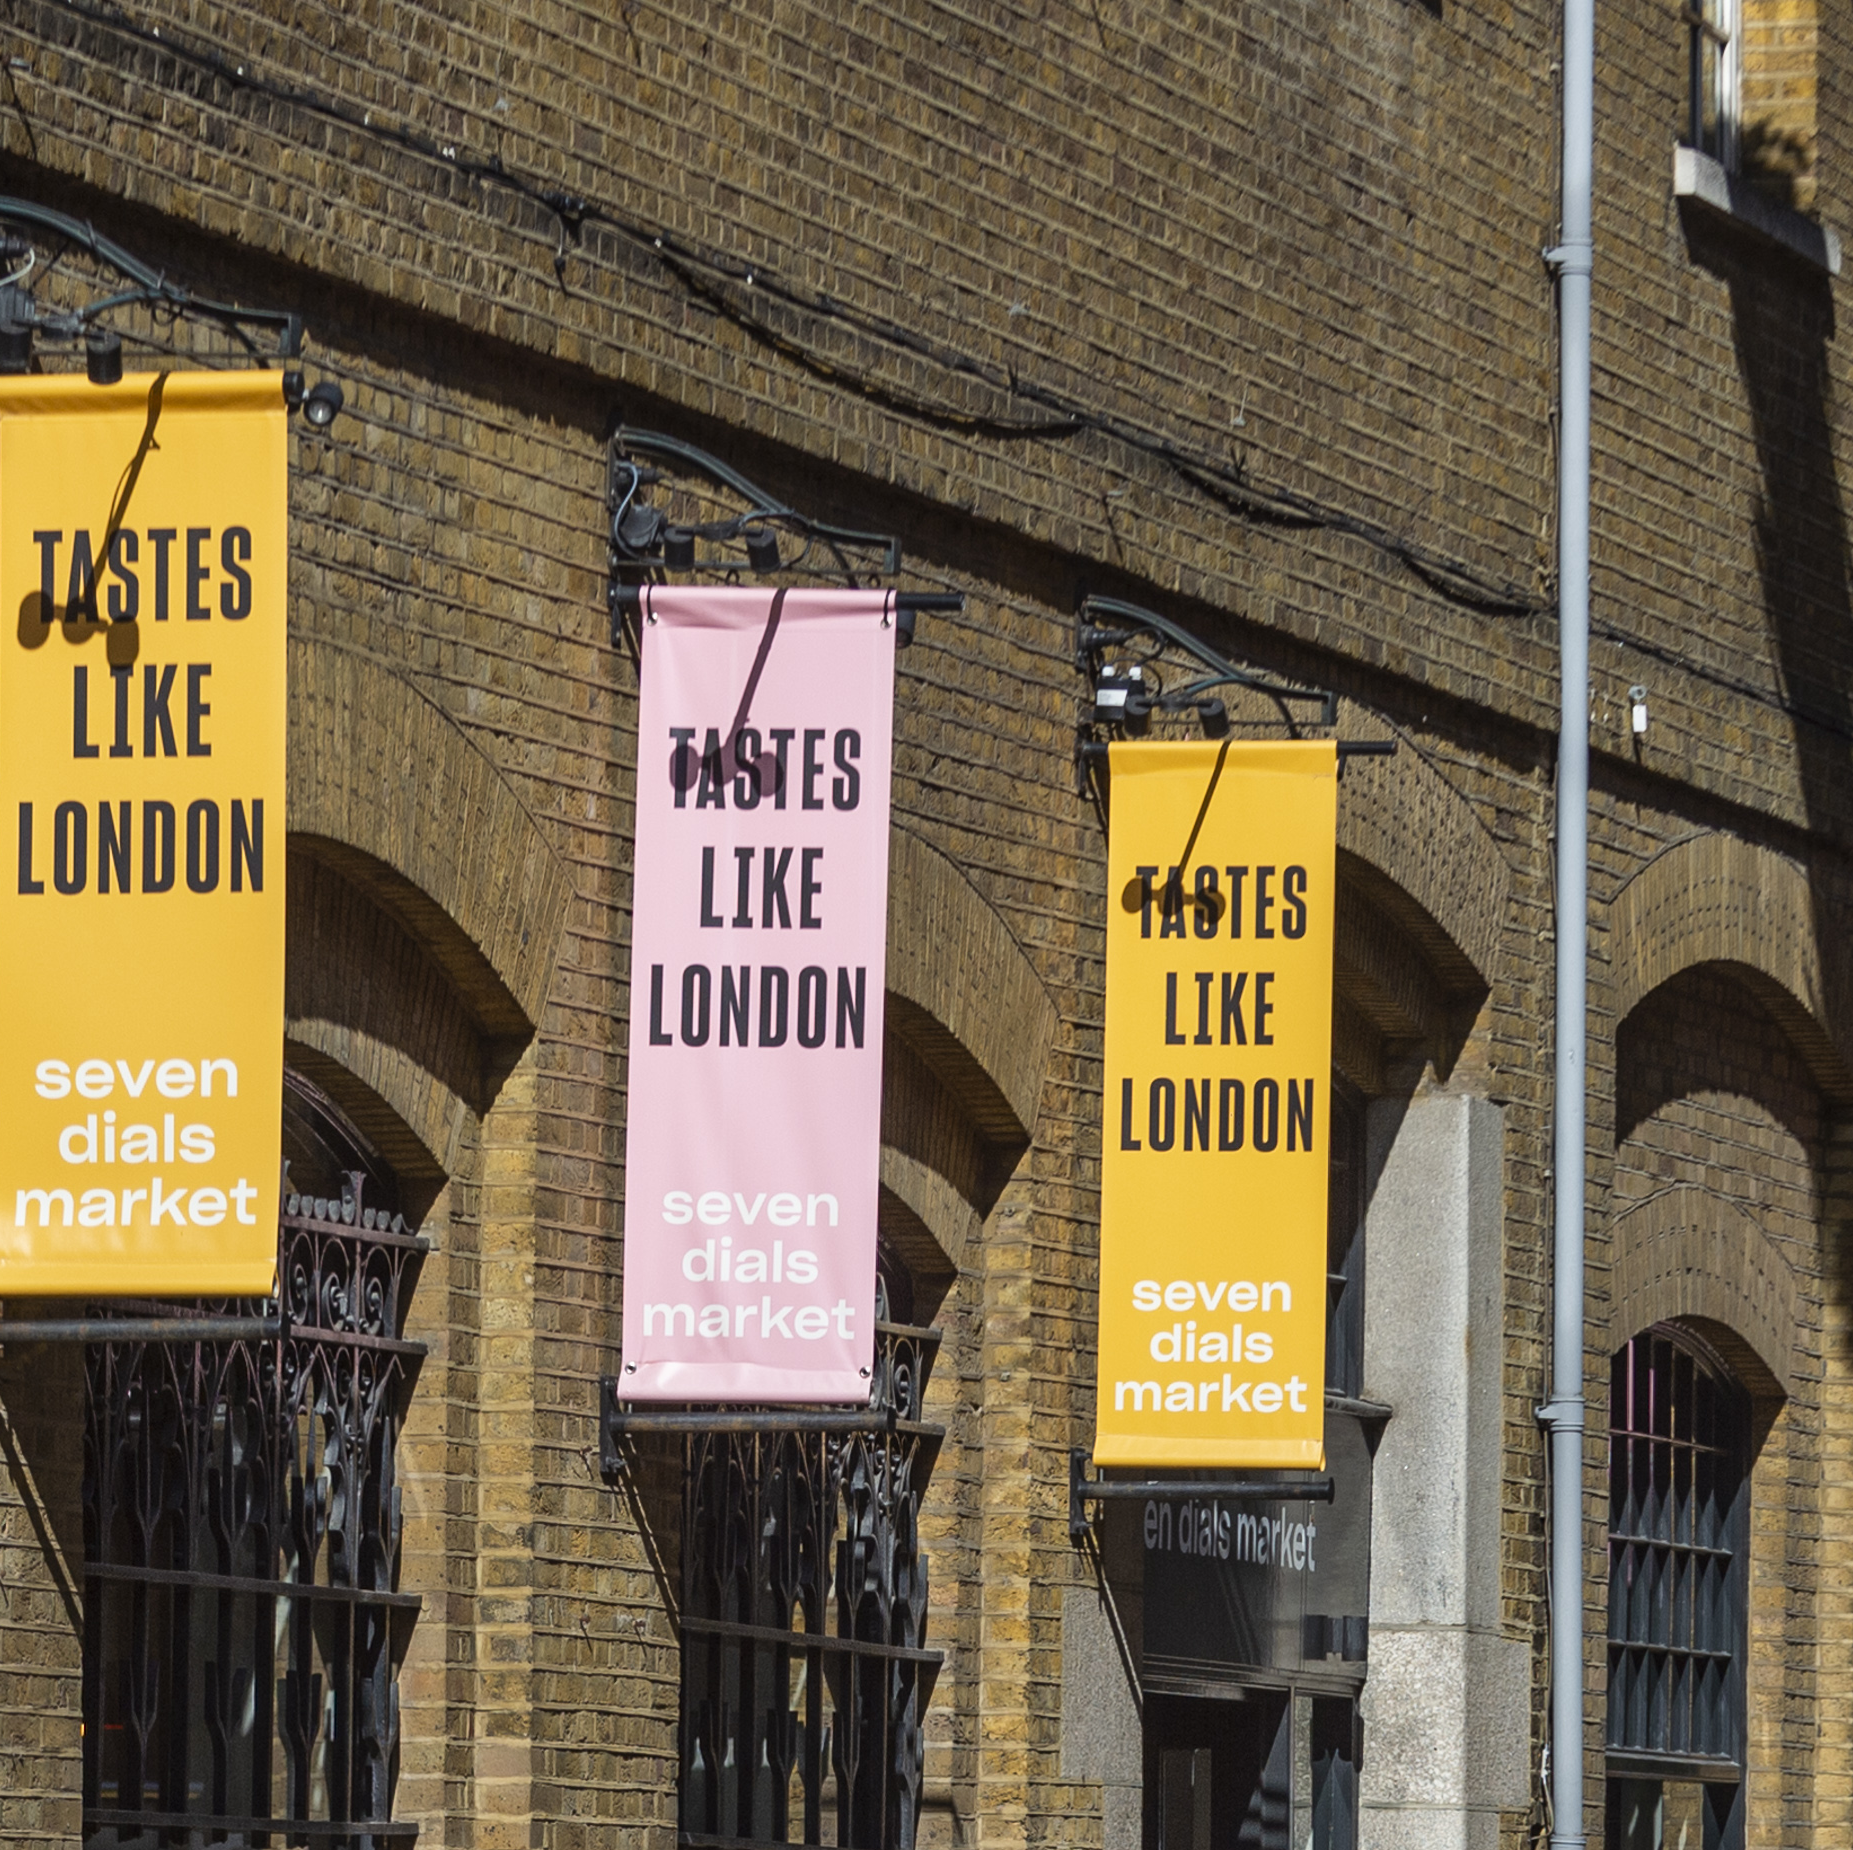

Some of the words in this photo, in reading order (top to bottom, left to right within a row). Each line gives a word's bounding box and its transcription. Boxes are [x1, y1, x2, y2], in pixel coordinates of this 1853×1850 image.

[33, 526, 254, 624] TASTES
[72, 664, 213, 758] LIKE
[667, 726, 861, 812] TASTES
[17, 798, 264, 896] LONDON
[700, 847, 823, 930] LIKE
[1136, 864, 1308, 940] TASTES
[649, 963, 866, 1050] LONDON
[1164, 971, 1274, 1046] LIKE
[35, 1057, 238, 1099] seven
[58, 1110, 216, 1164] dials
[1120, 1077, 1314, 1154] LONDON
[13, 1175, 257, 1229] market
[662, 1188, 838, 1228] seven
[680, 1237, 818, 1284] dials
[1131, 1278, 1291, 1311] seven
[642, 1297, 855, 1341] market
[1149, 1321, 1273, 1363] dials
[1115, 1372, 1308, 1415] market
[1178, 1498, 1231, 1560] dials
[1237, 1507, 1316, 1572] market
